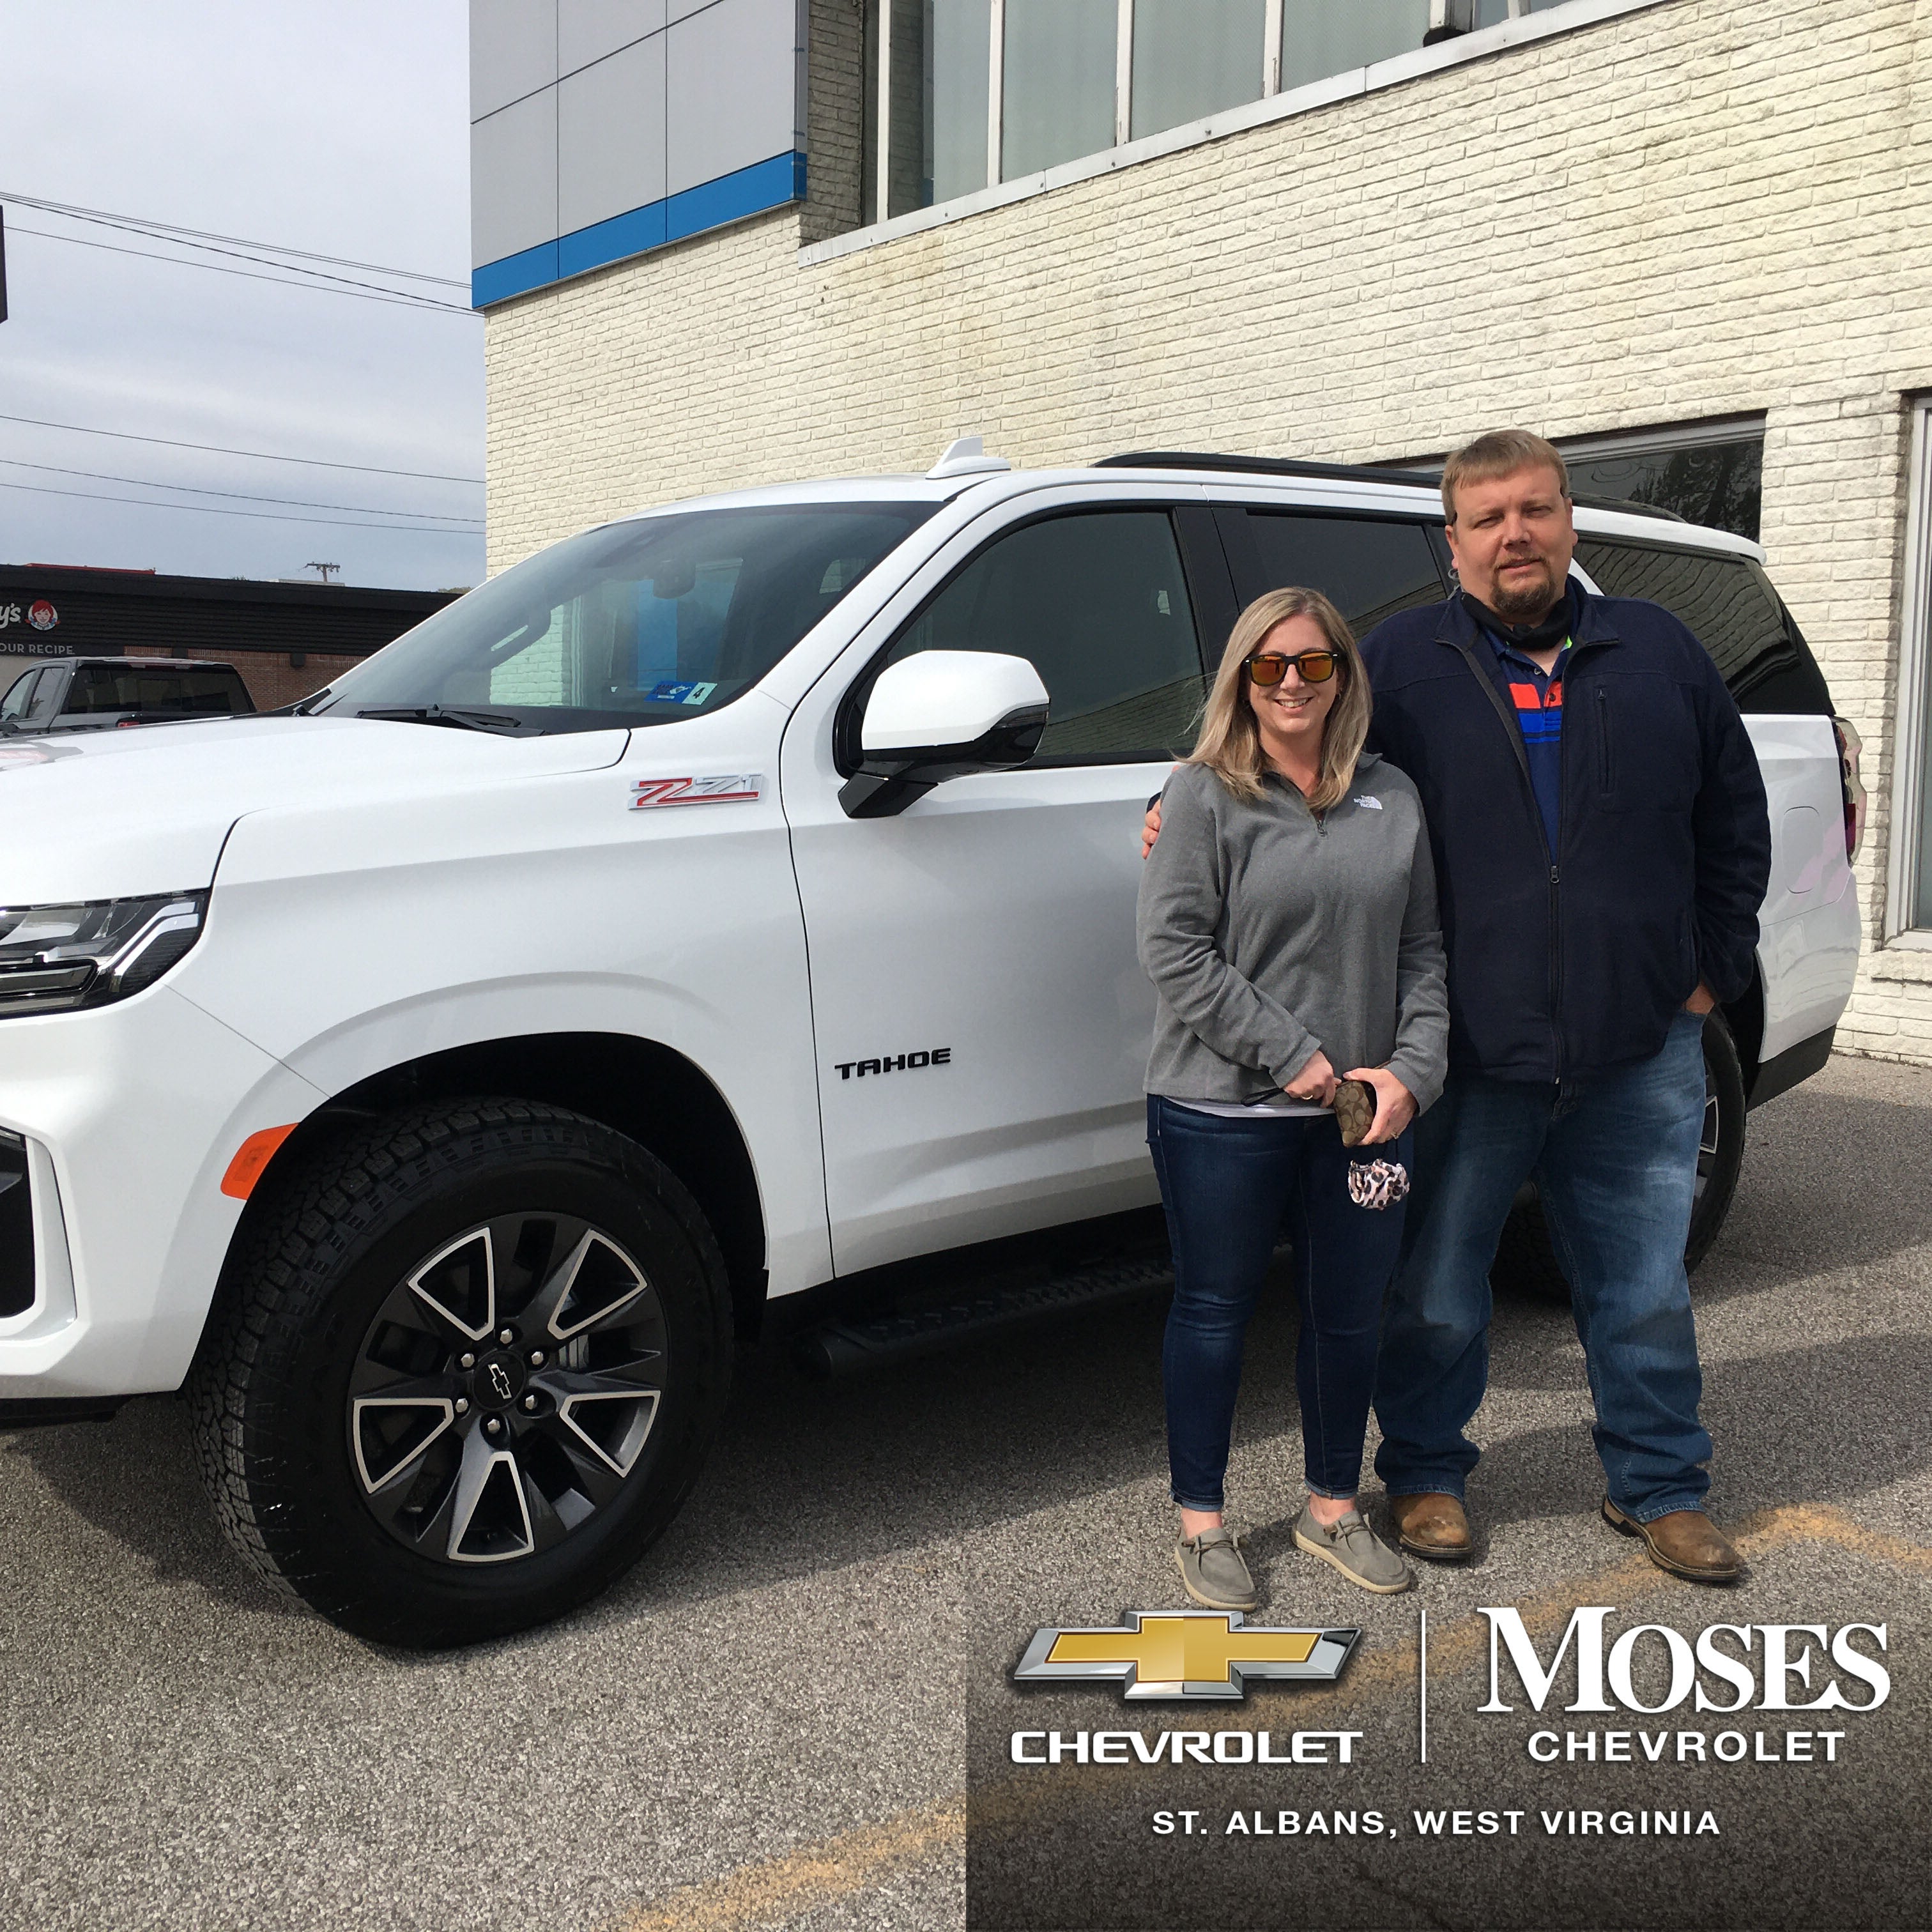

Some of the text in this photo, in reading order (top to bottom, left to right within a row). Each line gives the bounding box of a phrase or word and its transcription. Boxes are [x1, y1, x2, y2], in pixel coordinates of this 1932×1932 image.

[0, 643, 75, 655] OUR RECIPE
[628, 773, 762, 810] Z71
[834, 1047, 951, 1080] TAHOE
